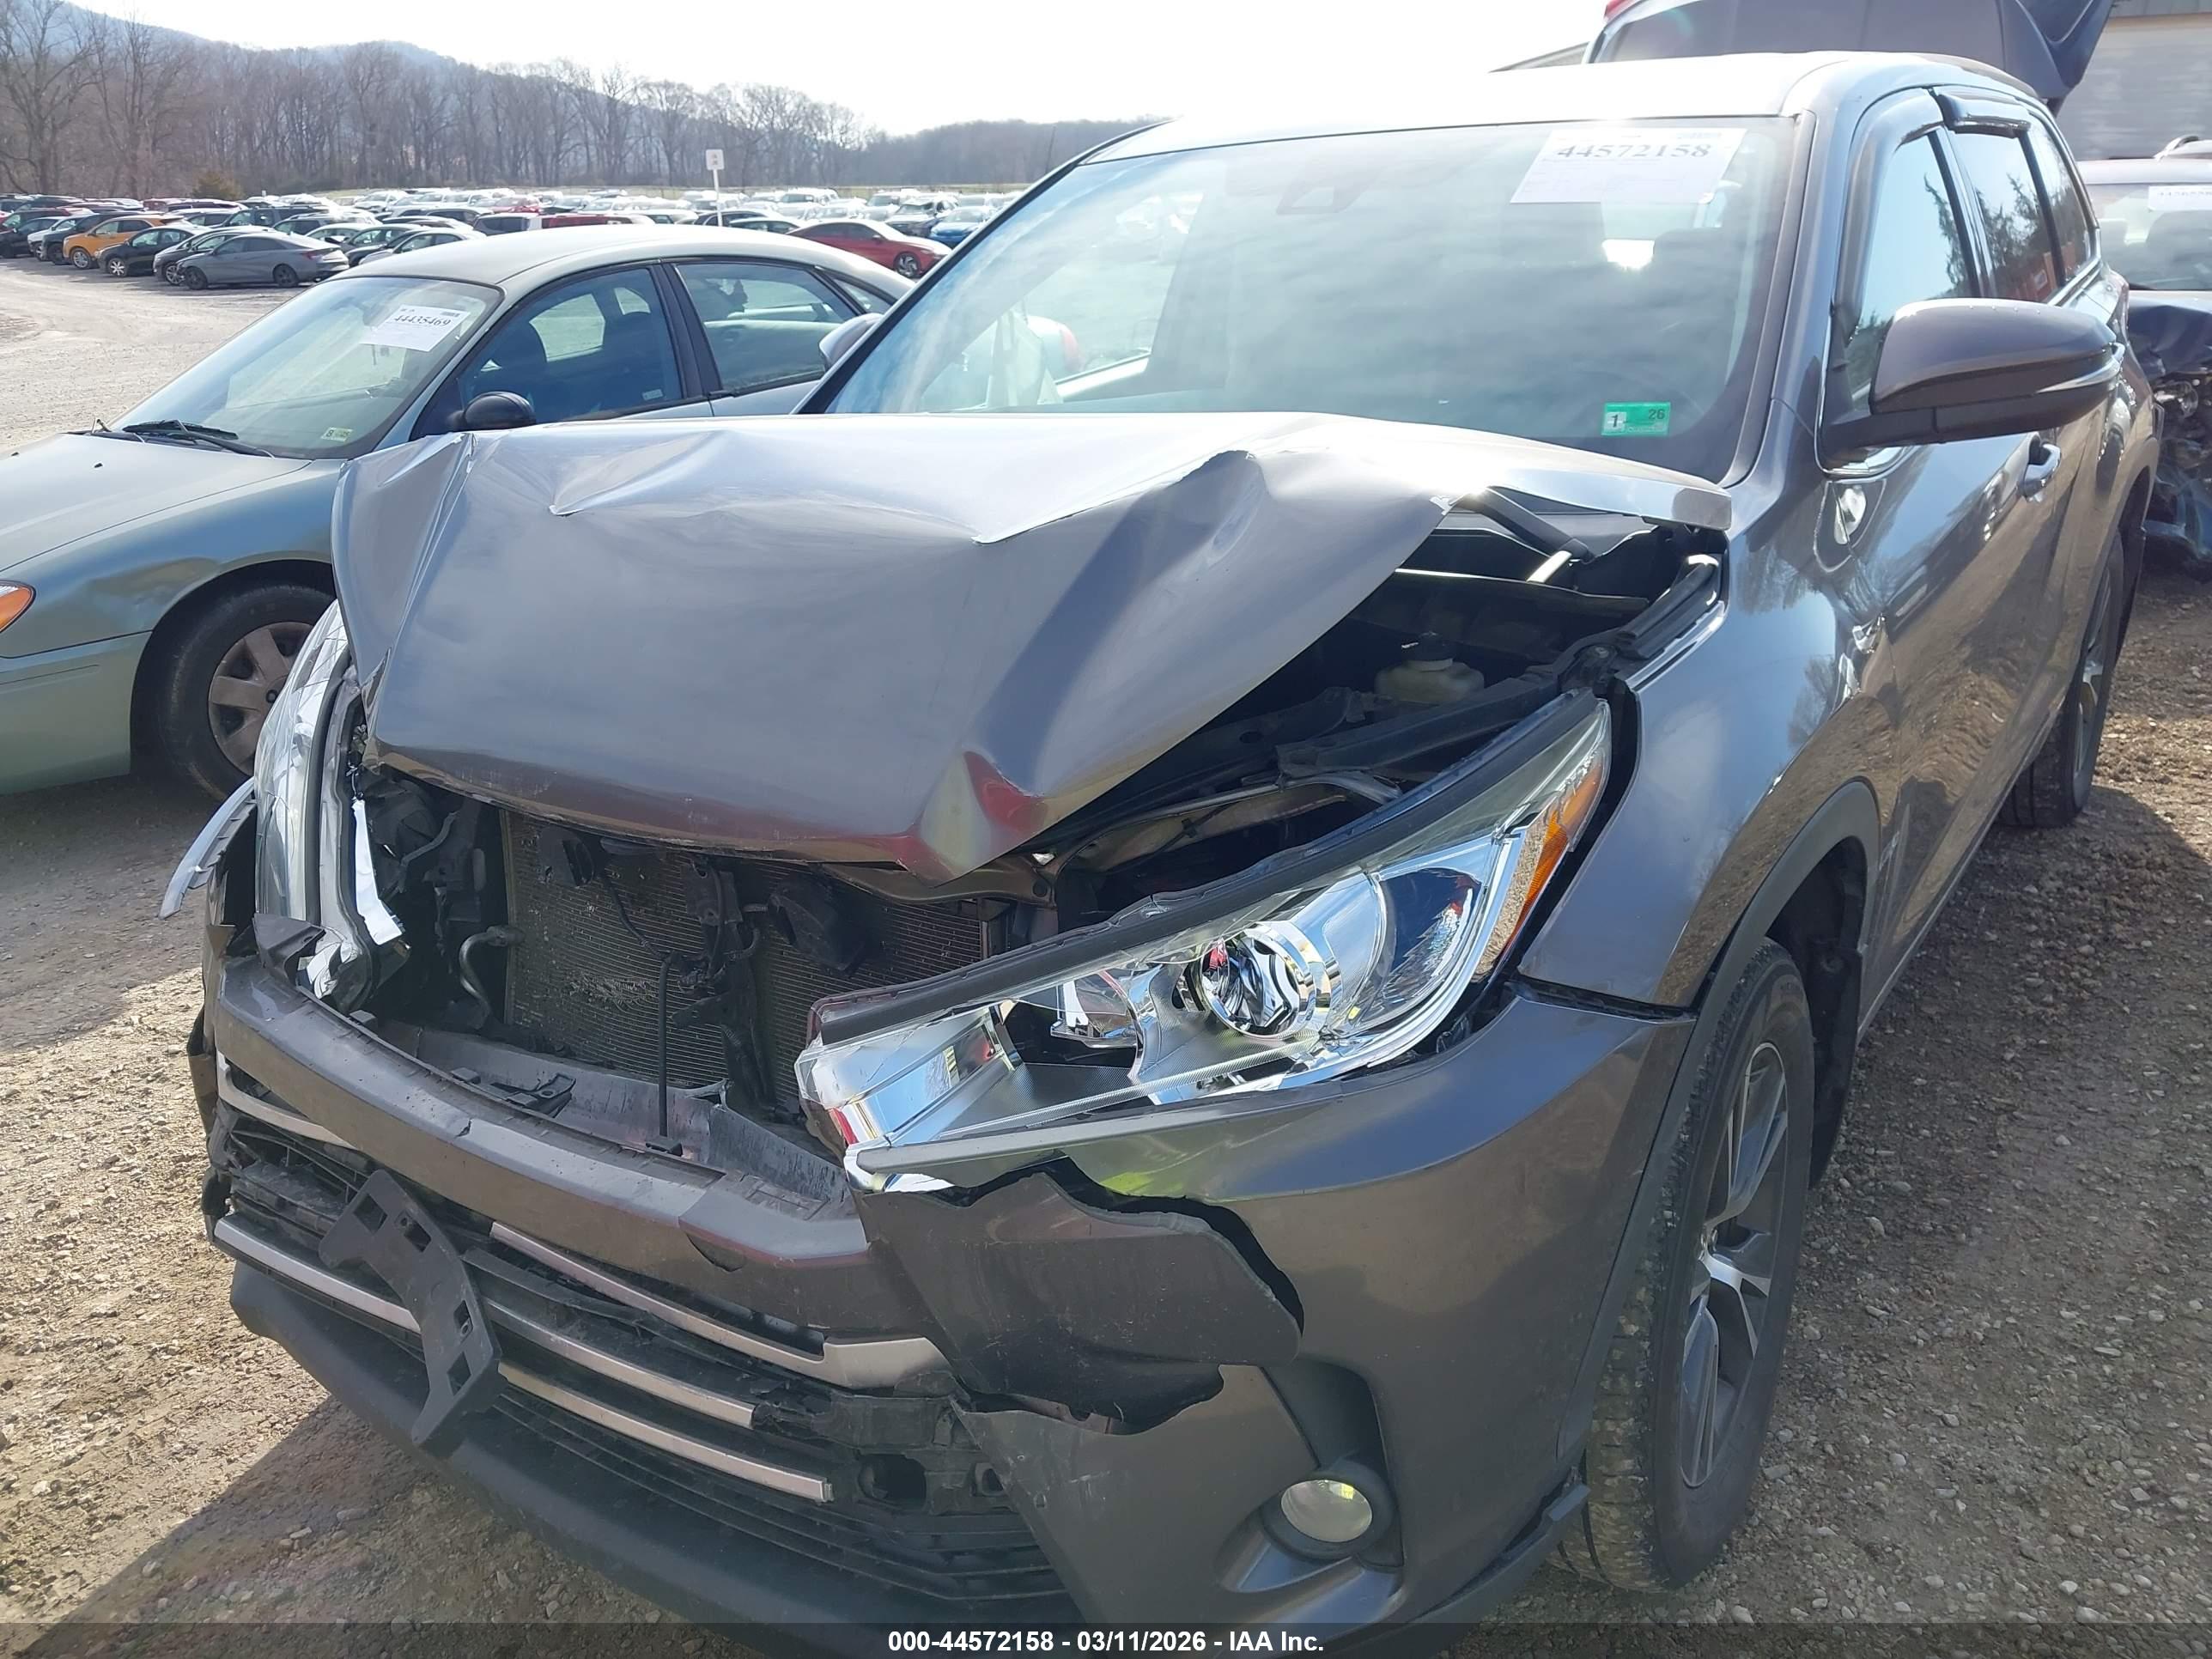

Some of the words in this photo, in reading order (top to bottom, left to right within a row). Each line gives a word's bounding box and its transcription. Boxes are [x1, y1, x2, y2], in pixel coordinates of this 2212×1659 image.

[1557, 143, 1711, 158] 44572158
[394, 314, 452, 326] 44435469
[1611, 414, 1619, 428] 1
[1648, 408, 1666, 420] 26
